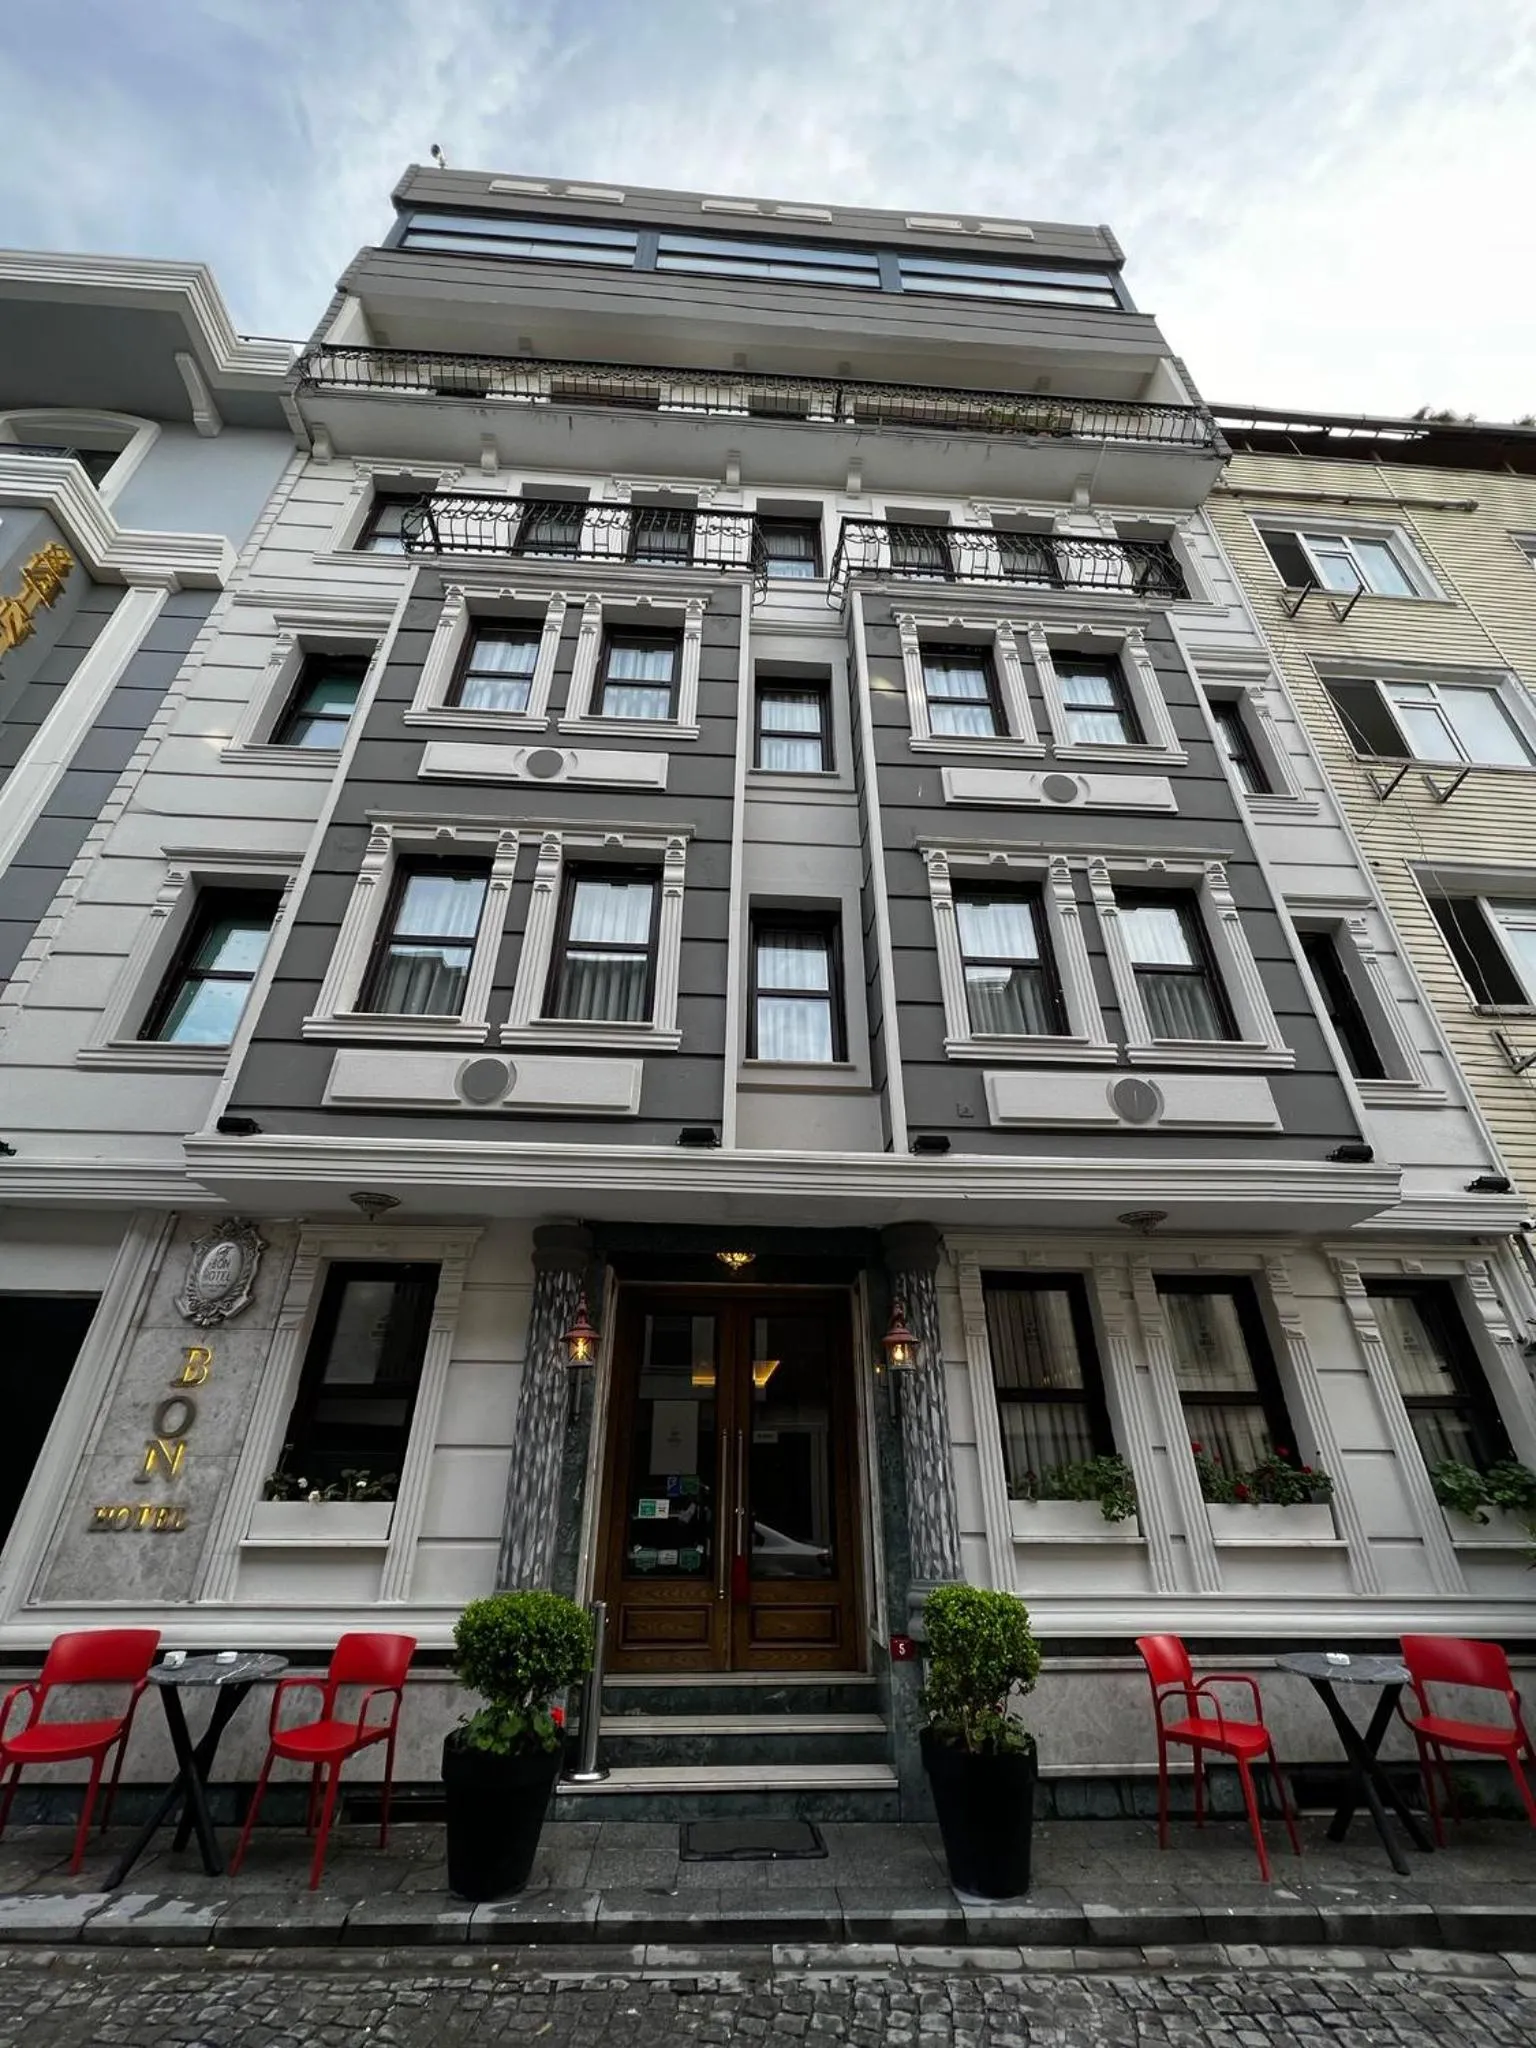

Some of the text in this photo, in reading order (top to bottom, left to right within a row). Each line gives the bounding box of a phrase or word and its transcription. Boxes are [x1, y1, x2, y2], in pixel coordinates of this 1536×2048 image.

[133, 1346, 212, 1484] BON
[88, 1503, 186, 1532] HOTEL
[899, 1643, 906, 1655] 5
